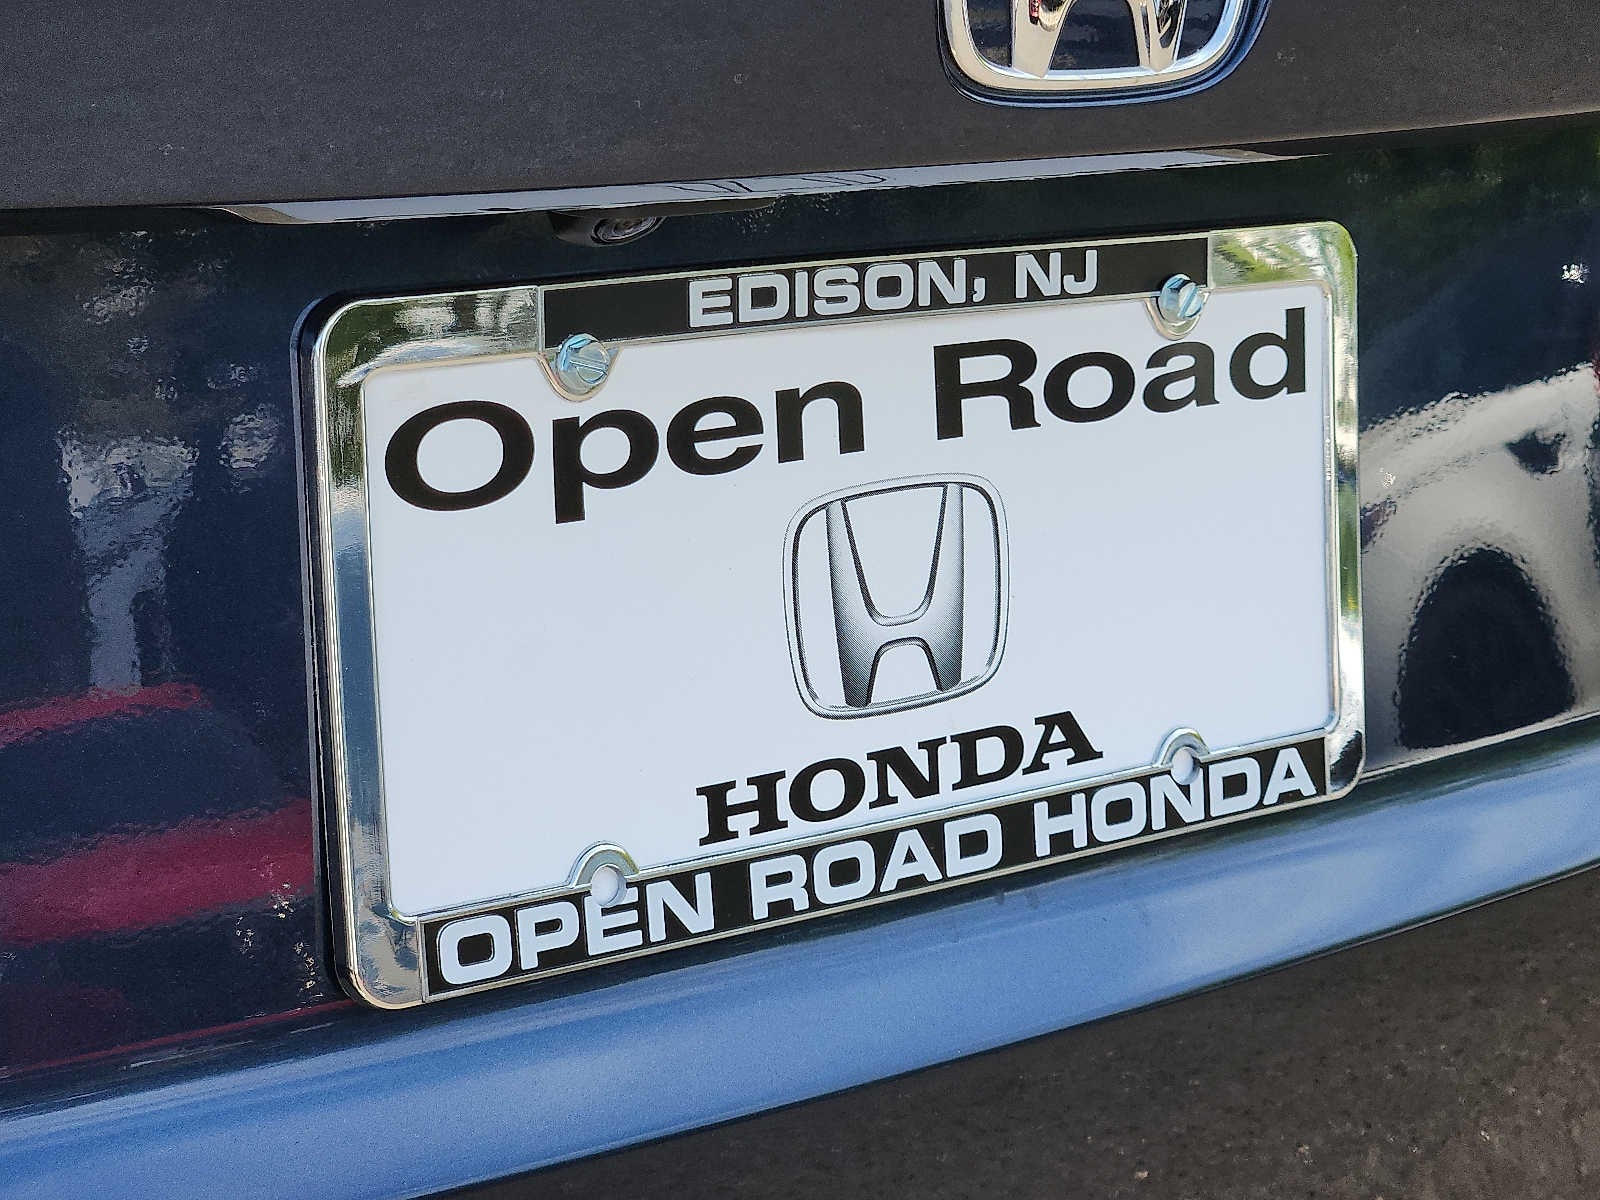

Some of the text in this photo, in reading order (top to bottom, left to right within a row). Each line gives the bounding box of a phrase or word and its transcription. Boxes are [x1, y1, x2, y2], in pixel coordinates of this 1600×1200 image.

[689, 249, 1099, 327] EDISON, NJ
[385, 306, 1307, 524] Open Road
[436, 747, 1318, 986] OPEN ROAD HONDA
[696, 710, 1104, 847] HONDA
